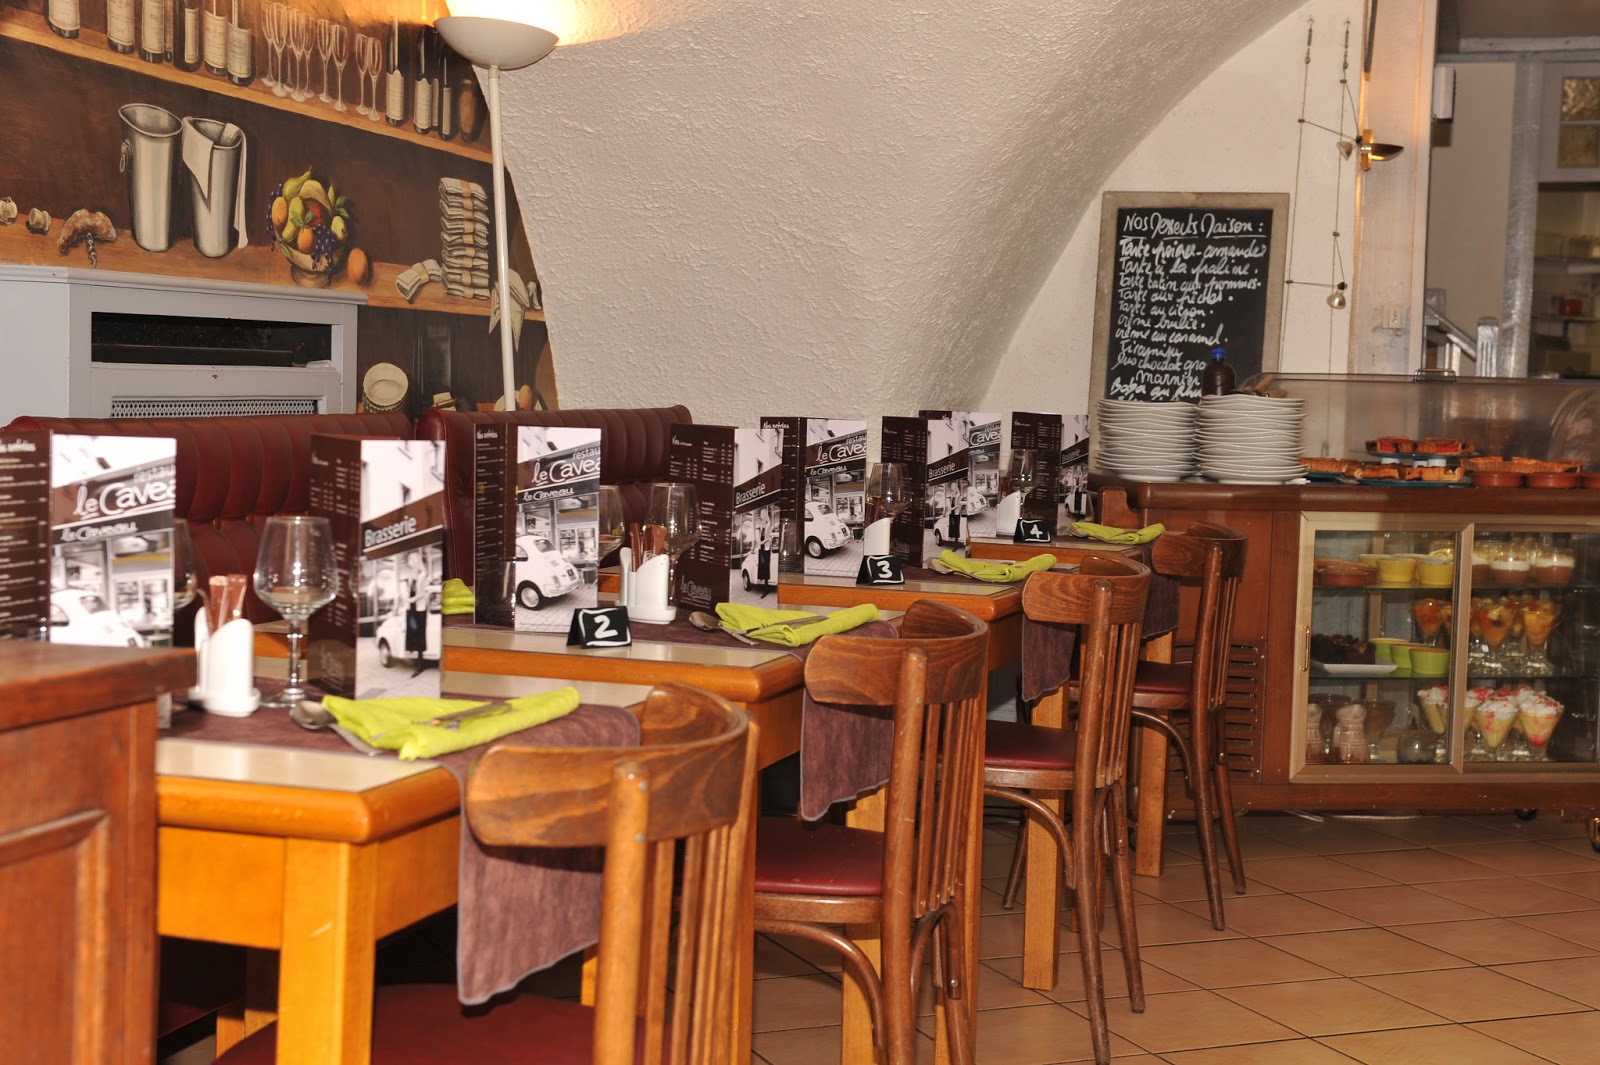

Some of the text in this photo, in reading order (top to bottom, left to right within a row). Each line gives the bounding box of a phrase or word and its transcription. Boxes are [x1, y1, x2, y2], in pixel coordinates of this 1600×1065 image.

[1123, 213, 1148, 231] Nos
[1150, 212, 1199, 238] Desserts
[1119, 238, 1150, 257] Tarte
[1119, 256, 1153, 275] Tarte
[1169, 257, 1188, 274] la
[1119, 272, 1144, 289] Tarte
[1118, 287, 1148, 302] Tarte
[1151, 291, 1174, 302] aux
[1118, 301, 1146, 315] Tarte
[1150, 305, 1166, 315] au
[1151, 331, 1167, 342] au
[1174, 384, 1203, 398] Rhu
[928, 461, 956, 479] Brasserie
[735, 482, 766, 504] Brasserie
[364, 515, 417, 547] Brasserie
[1029, 523, 1043, 539] 4
[876, 560, 893, 578] 3
[594, 614, 618, 639] 2
